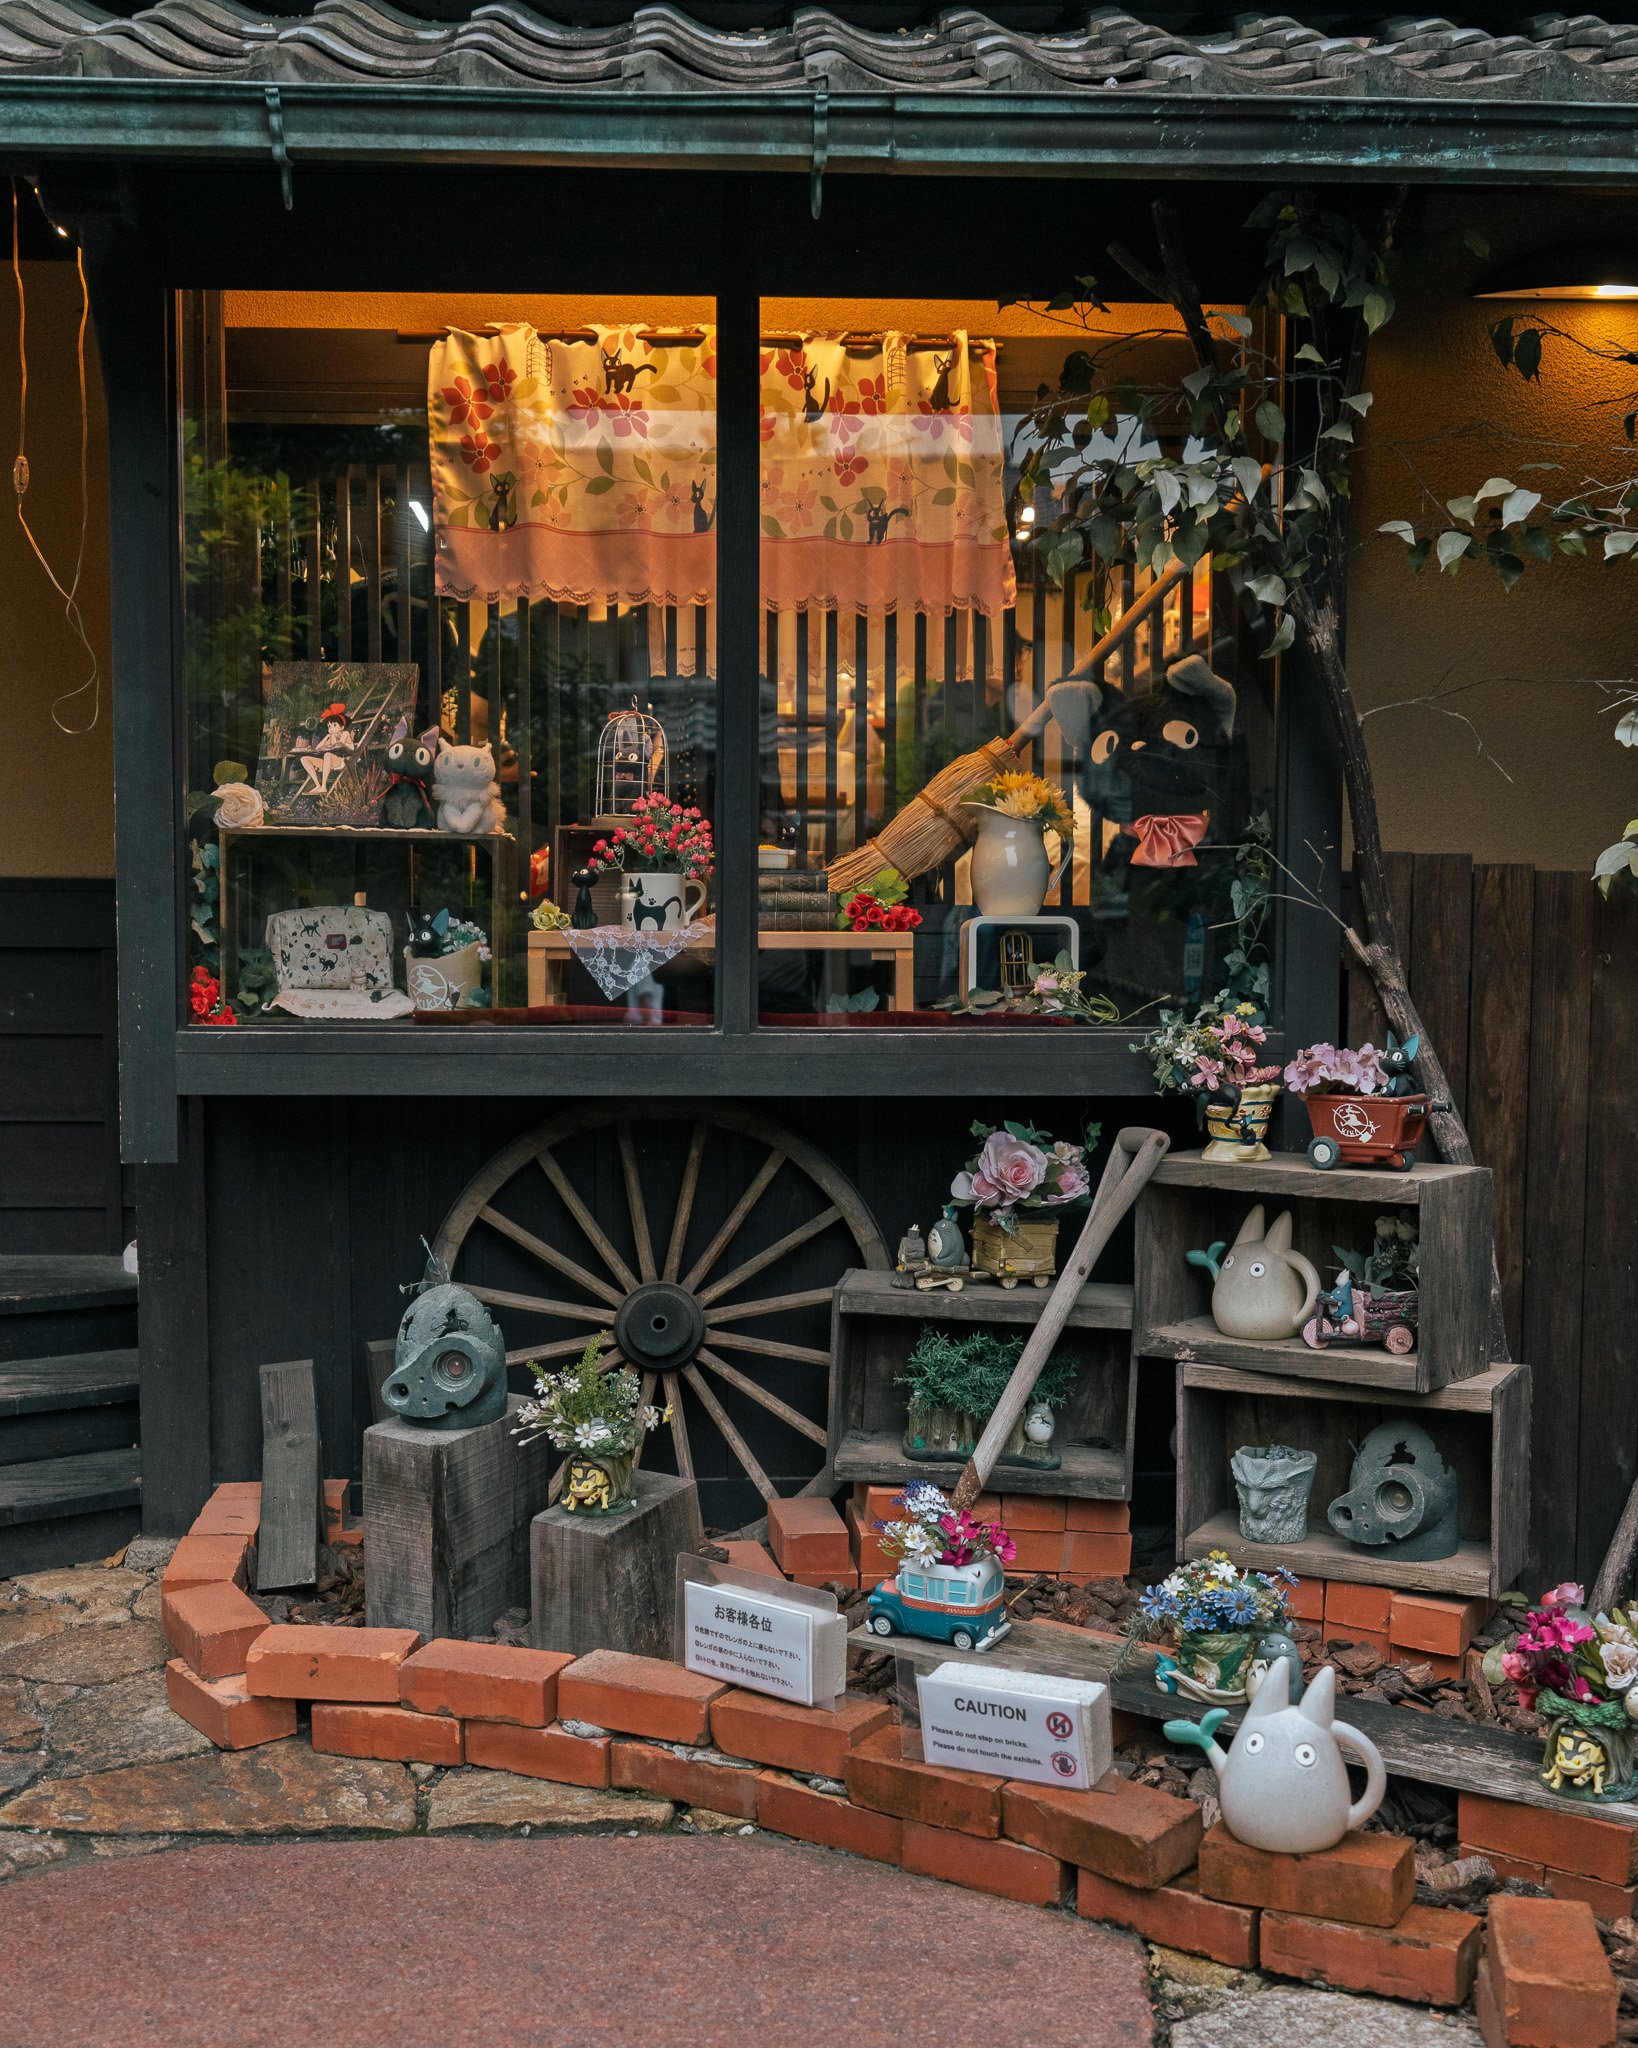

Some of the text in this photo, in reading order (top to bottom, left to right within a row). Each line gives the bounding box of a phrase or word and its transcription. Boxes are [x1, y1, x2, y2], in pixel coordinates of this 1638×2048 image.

[416, 997, 438, 1008] KIKI
[714, 1604, 773, 1633] お客様各位
[954, 1697, 1027, 1722] CAUTION
[931, 1725, 954, 1736] Please
[955, 1728, 964, 1738] do
[965, 1731, 977, 1740] not
[978, 1733, 993, 1743] step
[1005, 1738, 1029, 1749] bricks.
[932, 1740, 955, 1751] Please
[956, 1743, 965, 1752] do
[966, 1746, 978, 1755] not
[979, 1748, 1000, 1759] touch
[1000, 1752, 1012, 1761] the
[1013, 1754, 1044, 1766] exhibits.
